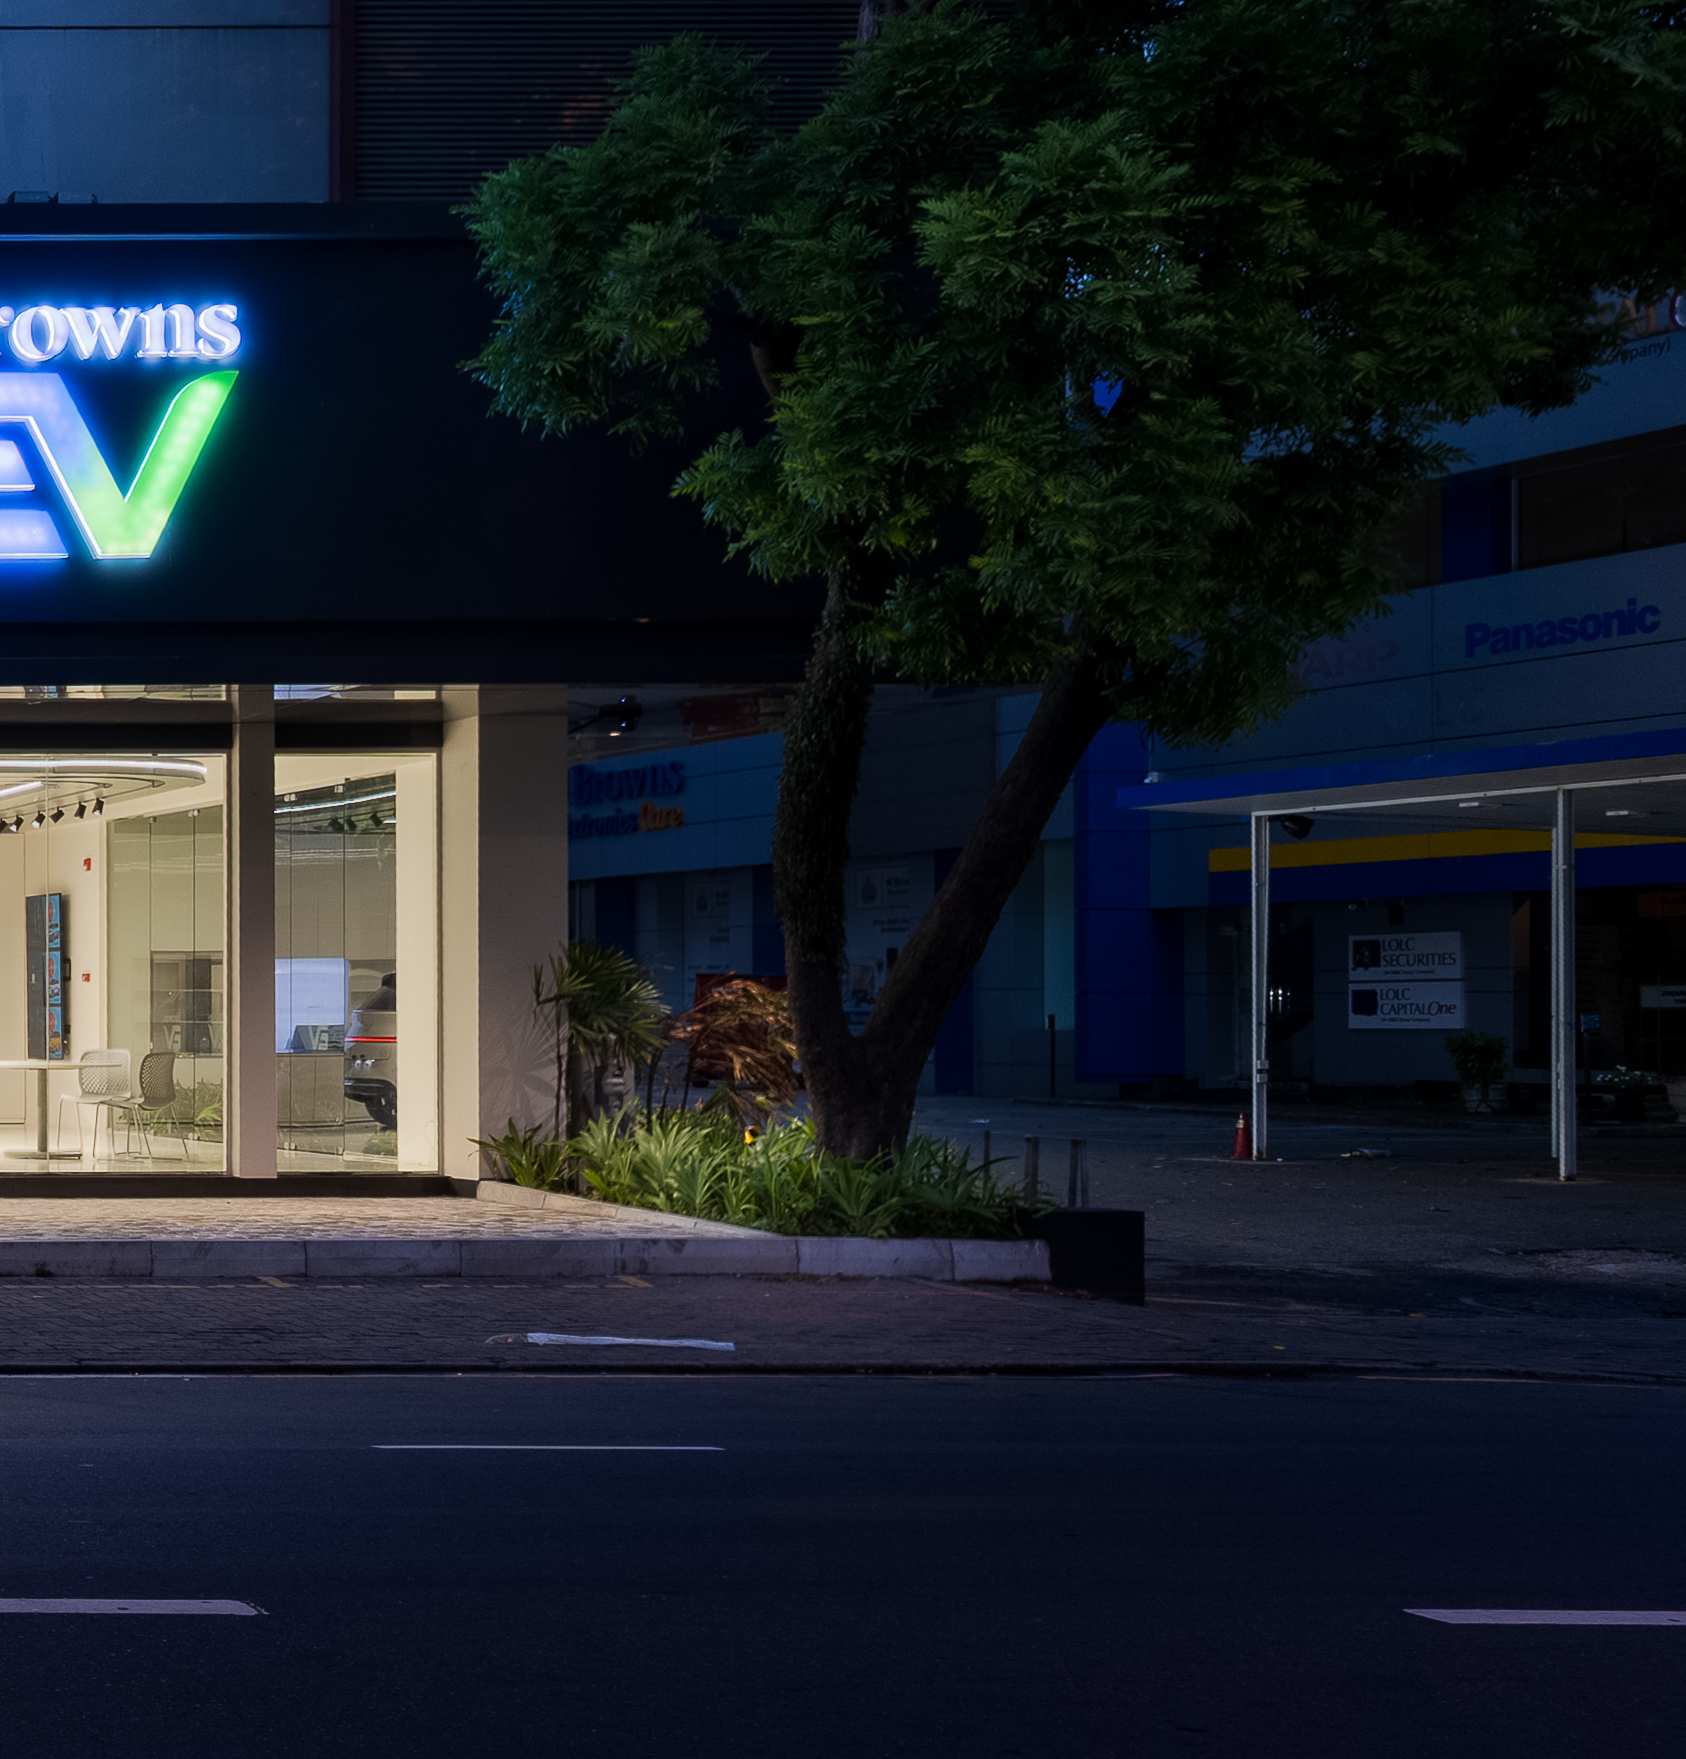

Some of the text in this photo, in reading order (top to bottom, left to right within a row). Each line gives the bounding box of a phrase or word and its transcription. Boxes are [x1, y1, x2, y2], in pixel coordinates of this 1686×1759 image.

[1464, 596, 1662, 659] Panasonic
[1382, 937, 1416, 952] LOLC
[1382, 952, 1457, 968] SECURITIES
[1379, 987, 1411, 1001] LOLC
